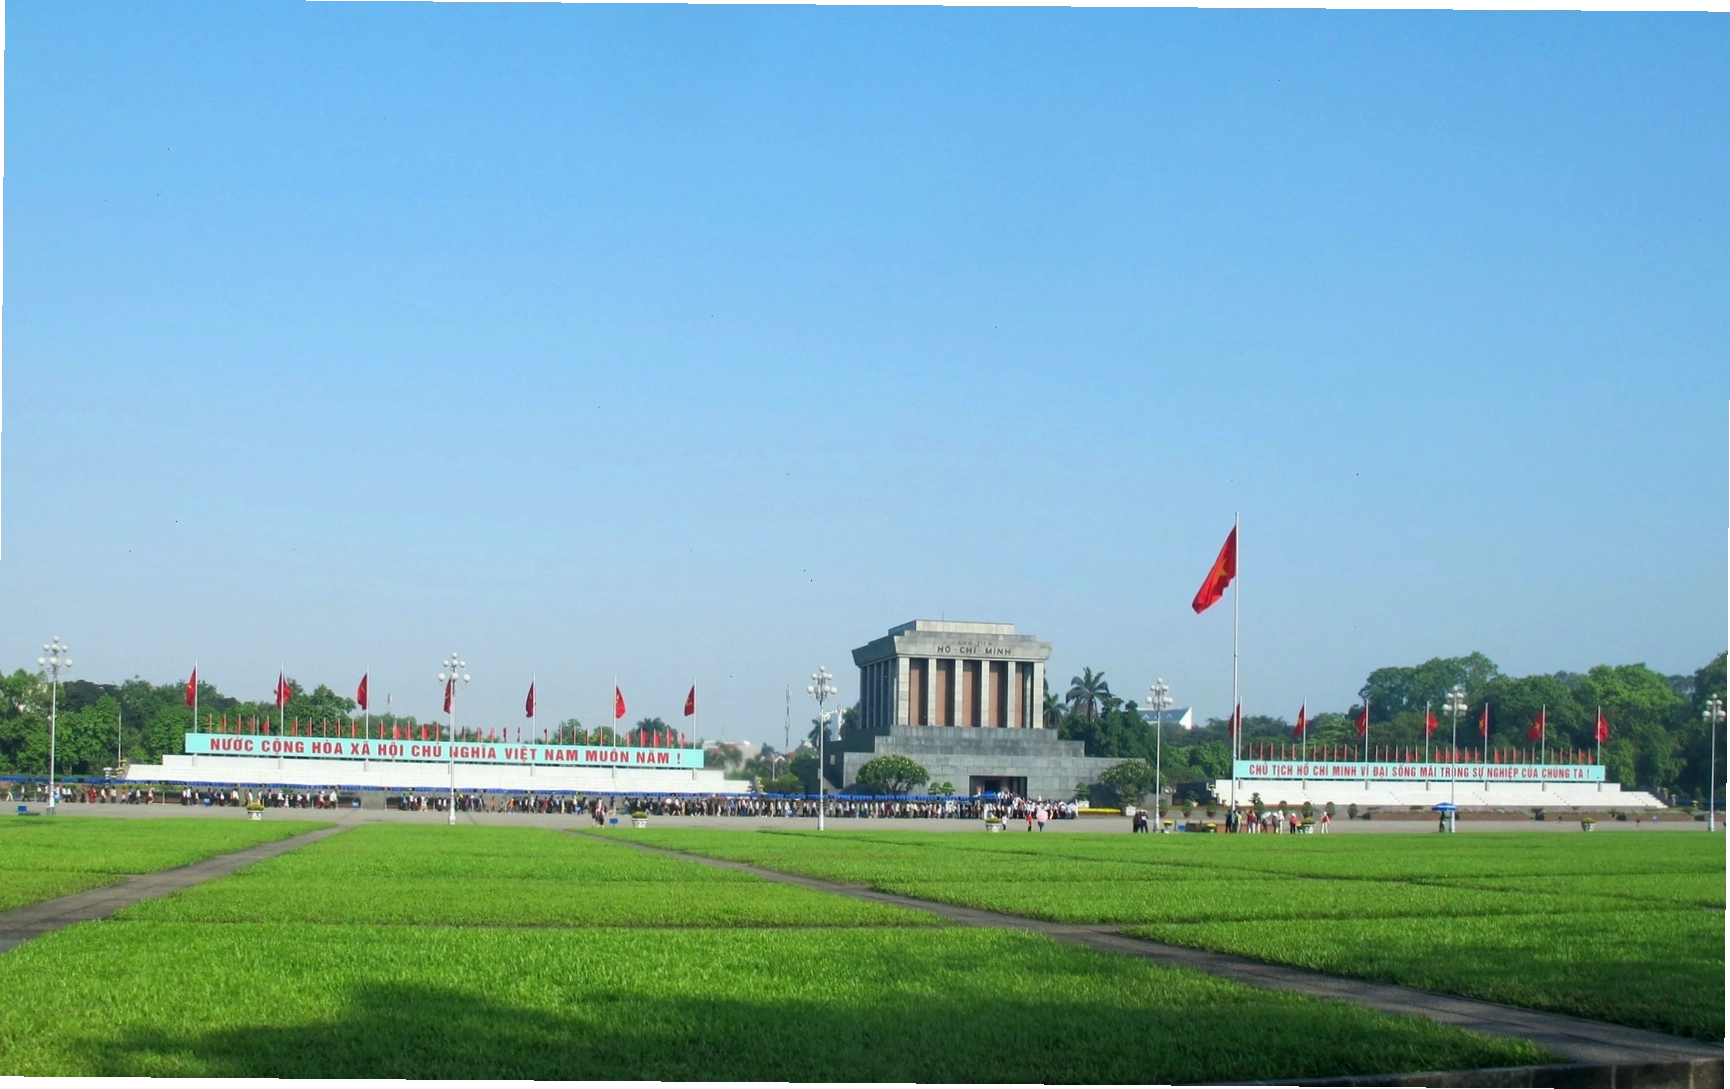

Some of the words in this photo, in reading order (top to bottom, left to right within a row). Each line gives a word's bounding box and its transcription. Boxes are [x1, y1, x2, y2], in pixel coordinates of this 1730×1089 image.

[985, 647, 1011, 655] MINH
[210, 736, 254, 751] NƯỚC
[261, 738, 304, 755] CỘNG
[312, 739, 343, 754] HÒA
[350, 740, 370, 755] XÃ
[377, 741, 404, 758] HỘI
[411, 742, 441, 757] CHỦ
[449, 744, 496, 759] NGHĨA
[504, 745, 537, 762] VIỆT
[544, 748, 578, 761] NAM
[585, 746, 629, 761] MUÔN
[636, 748, 669, 763] NĂM
[1249, 762, 1268, 775] CHỦ
[1272, 764, 1293, 777] TỊCH
[1332, 766, 1357, 776] MINH
[1440, 767, 1469, 777] TRONG
[1472, 766, 1484, 779] SỰ
[1487, 766, 1519, 780] NGHIỆP
[1521, 765, 1538, 778] CỦA
[1573, 768, 1584, 778] TA
